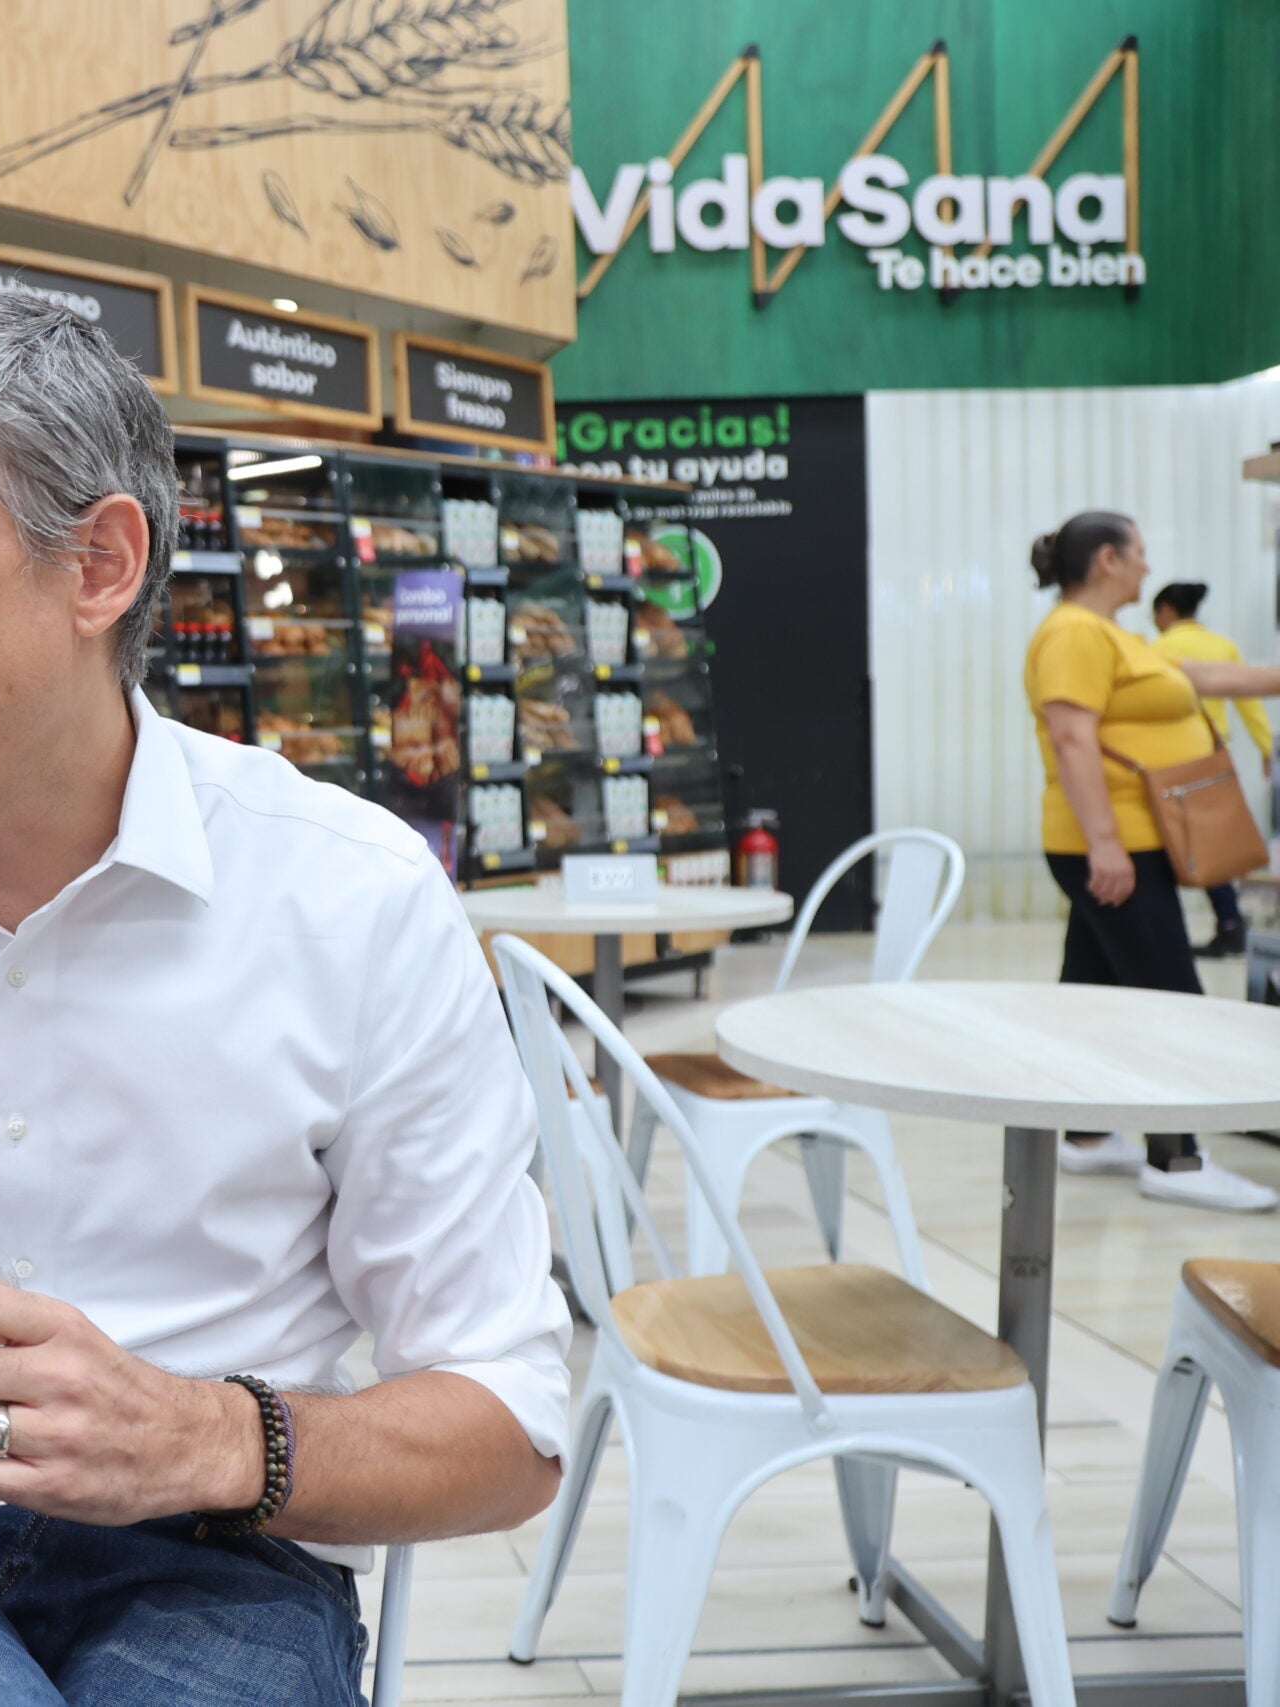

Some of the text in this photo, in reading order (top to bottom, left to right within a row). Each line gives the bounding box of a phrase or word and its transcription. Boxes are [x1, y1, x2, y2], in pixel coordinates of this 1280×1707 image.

[569, 153, 1127, 255] Vida Sana
[867, 244, 1146, 290] Te hace bien
[226, 319, 338, 368] Auténtico
[250, 360, 318, 396] sabor
[434, 361, 513, 402] Siempre
[445, 392, 506, 430] fresco
[556, 402, 791, 462] ¡Gracias!
[628, 454, 669, 484] tu
[674, 448, 789, 486] ayuda
